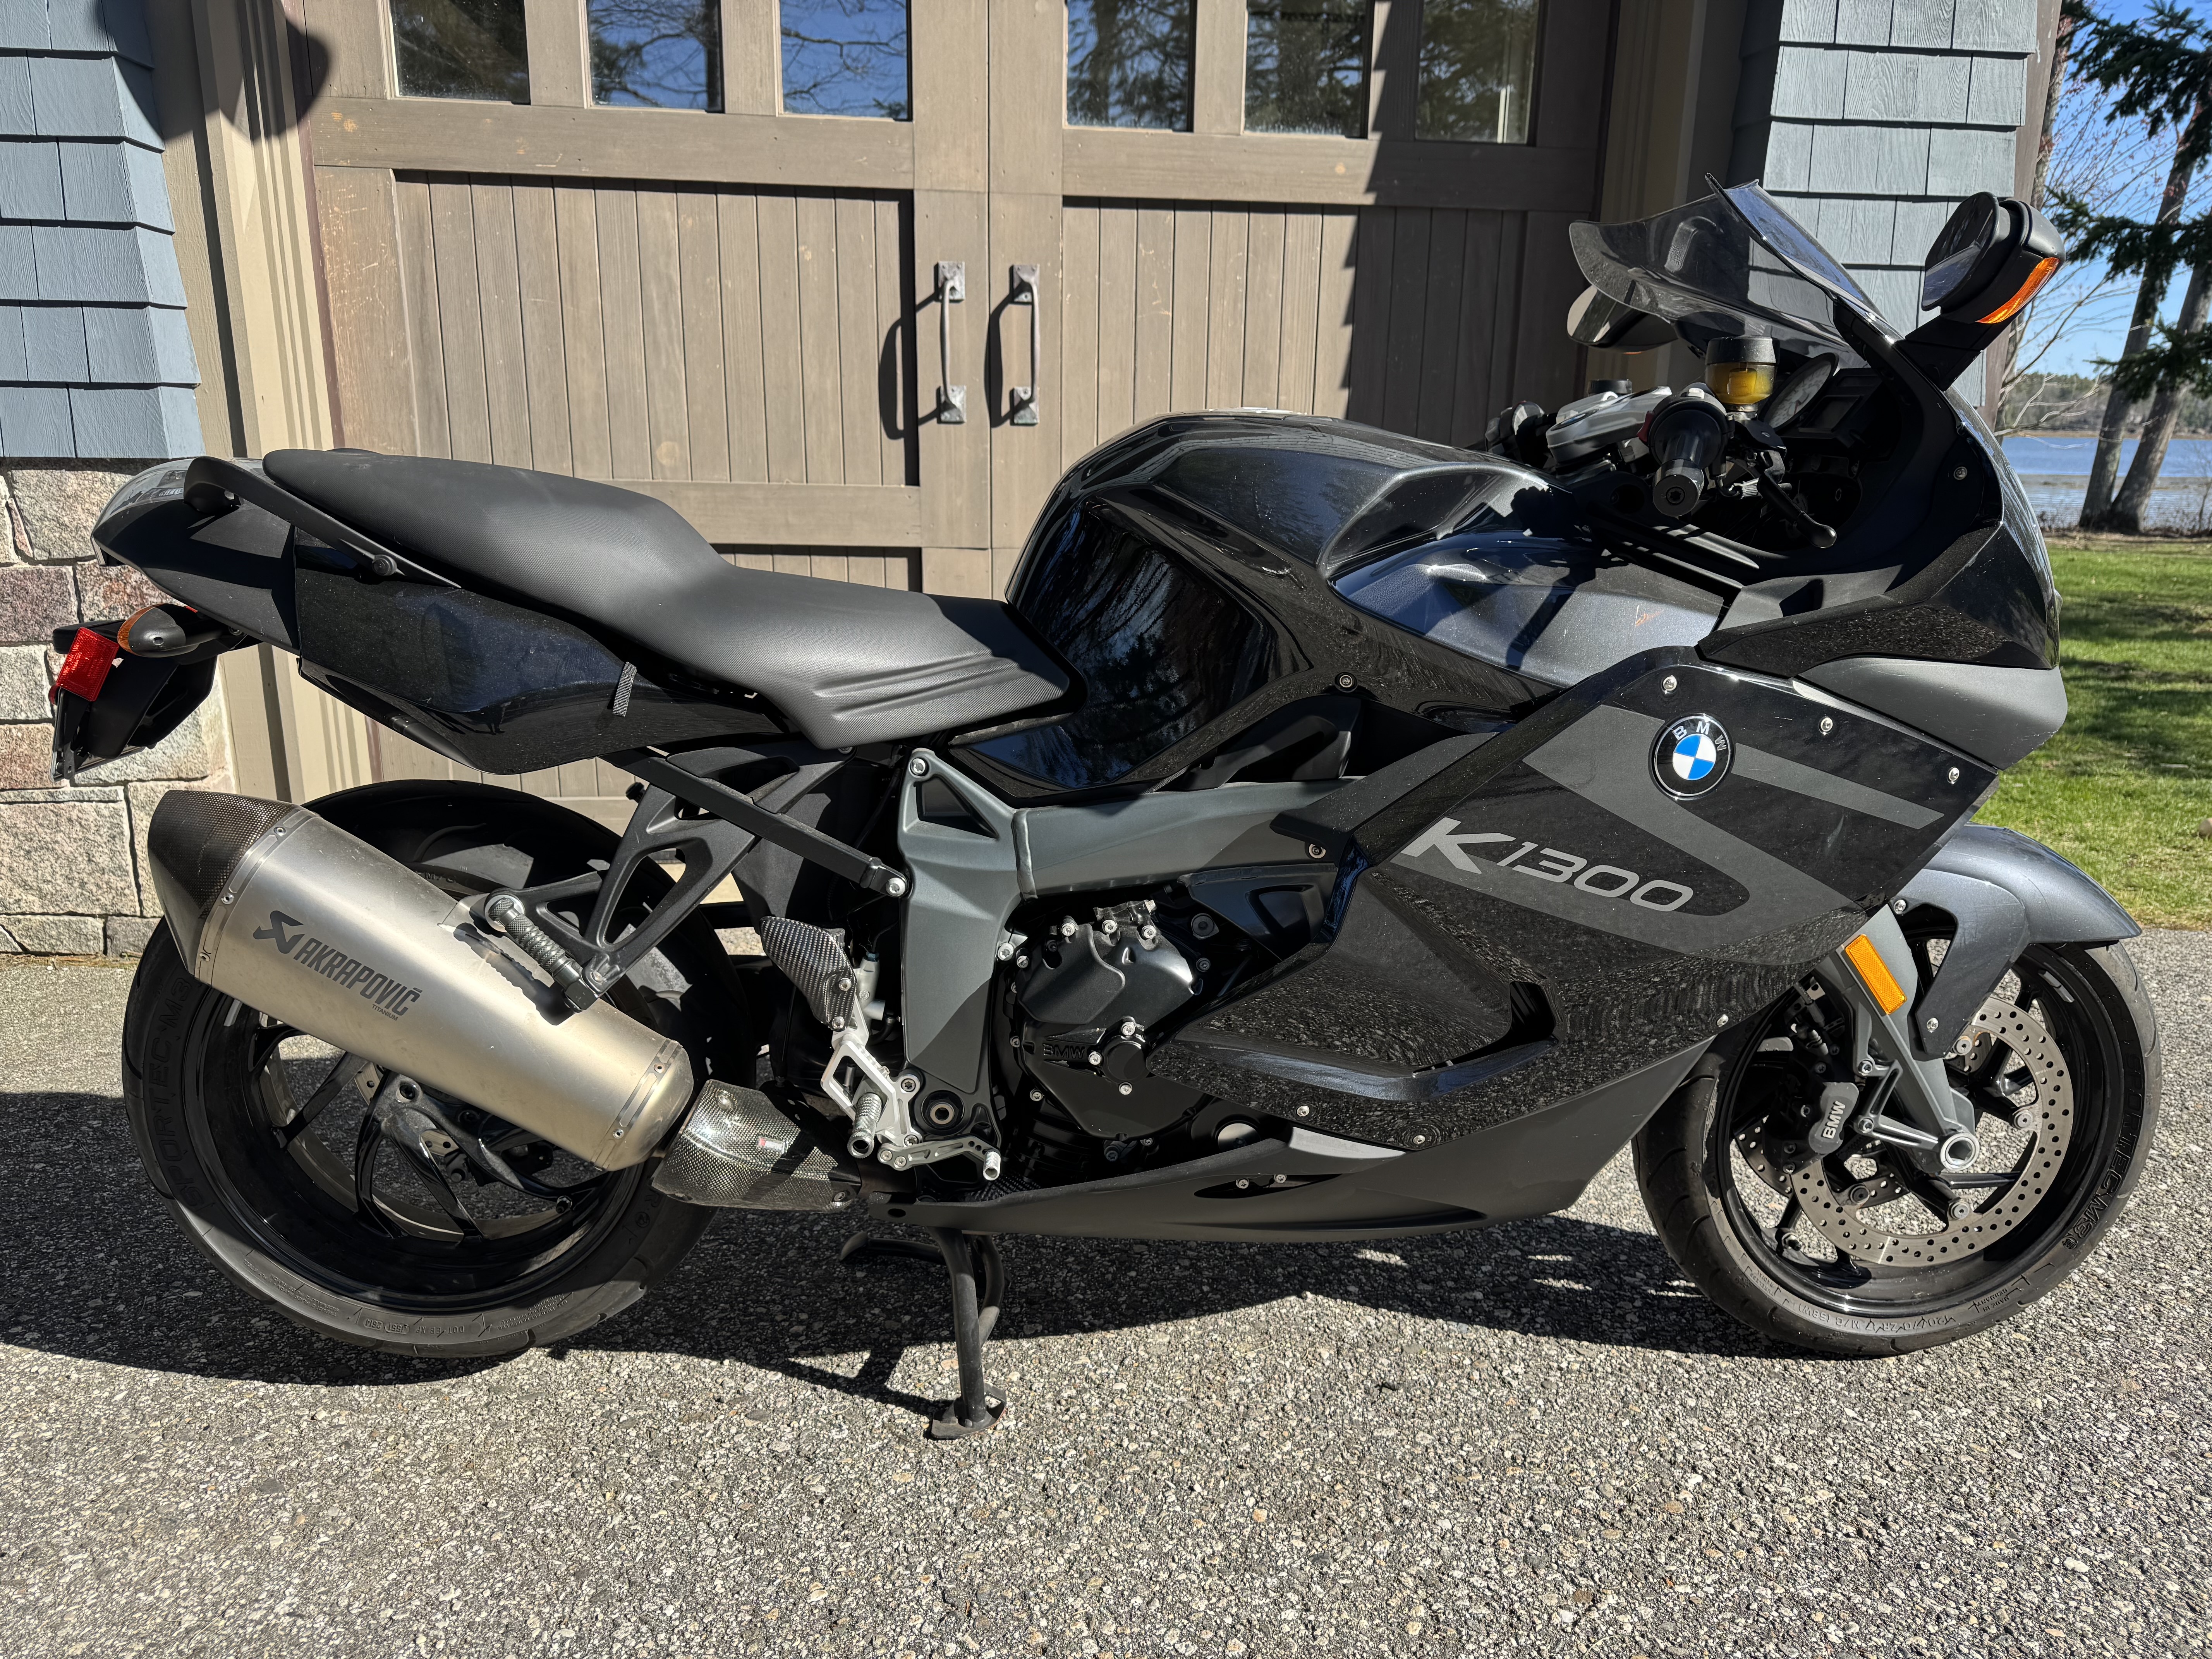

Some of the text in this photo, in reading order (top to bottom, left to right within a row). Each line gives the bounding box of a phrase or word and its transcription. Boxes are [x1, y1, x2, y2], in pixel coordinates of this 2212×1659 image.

[1672, 721, 1727, 750] BMW
[372, 1004, 398, 1021] TITANIUM
[1043, 1044, 1085, 1059] BMW
[1821, 1101, 1846, 1139] BMW
[2073, 1054, 2143, 1239] SPORTEC M3
[448, 1326, 464, 1334] DOT
